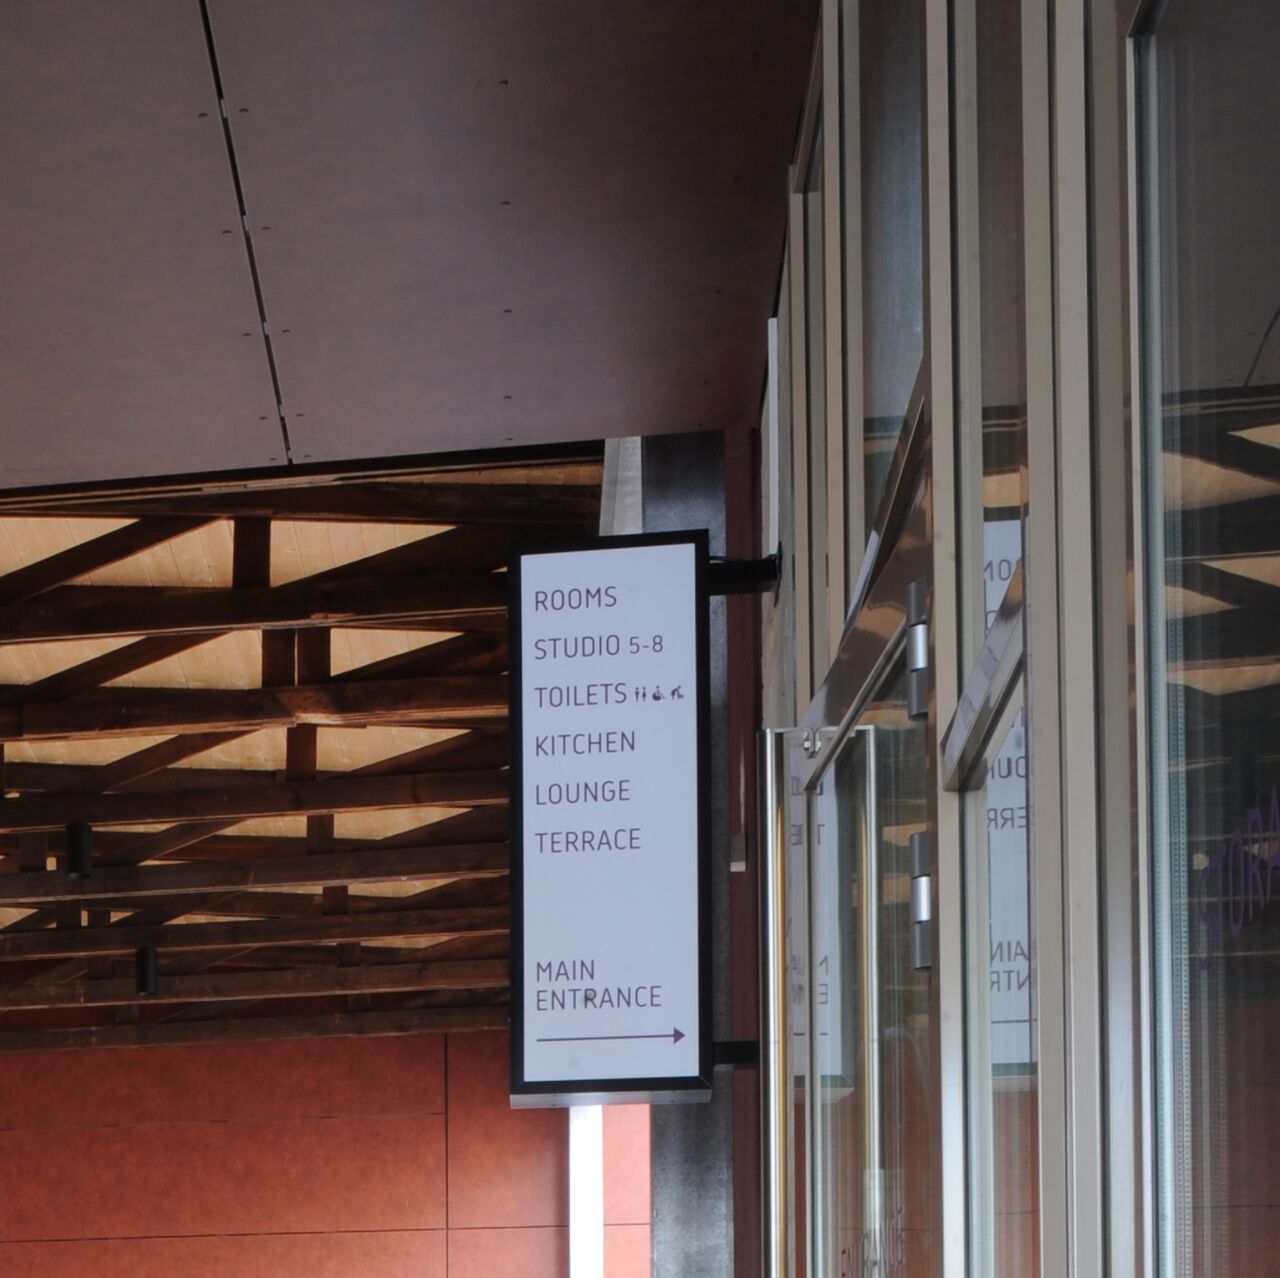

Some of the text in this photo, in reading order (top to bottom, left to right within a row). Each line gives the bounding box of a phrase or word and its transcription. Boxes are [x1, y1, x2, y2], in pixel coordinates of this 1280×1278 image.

[534, 586, 618, 612] ROOMS
[534, 634, 664, 660] STUDIO 5-8
[534, 683, 628, 708] TOILETS
[535, 731, 636, 757] KITCHEN
[535, 780, 632, 805] LOUNGE
[534, 828, 642, 854] TERRACE
[536, 960, 595, 982] MAIN
[536, 985, 663, 1011] ENTRANCE
